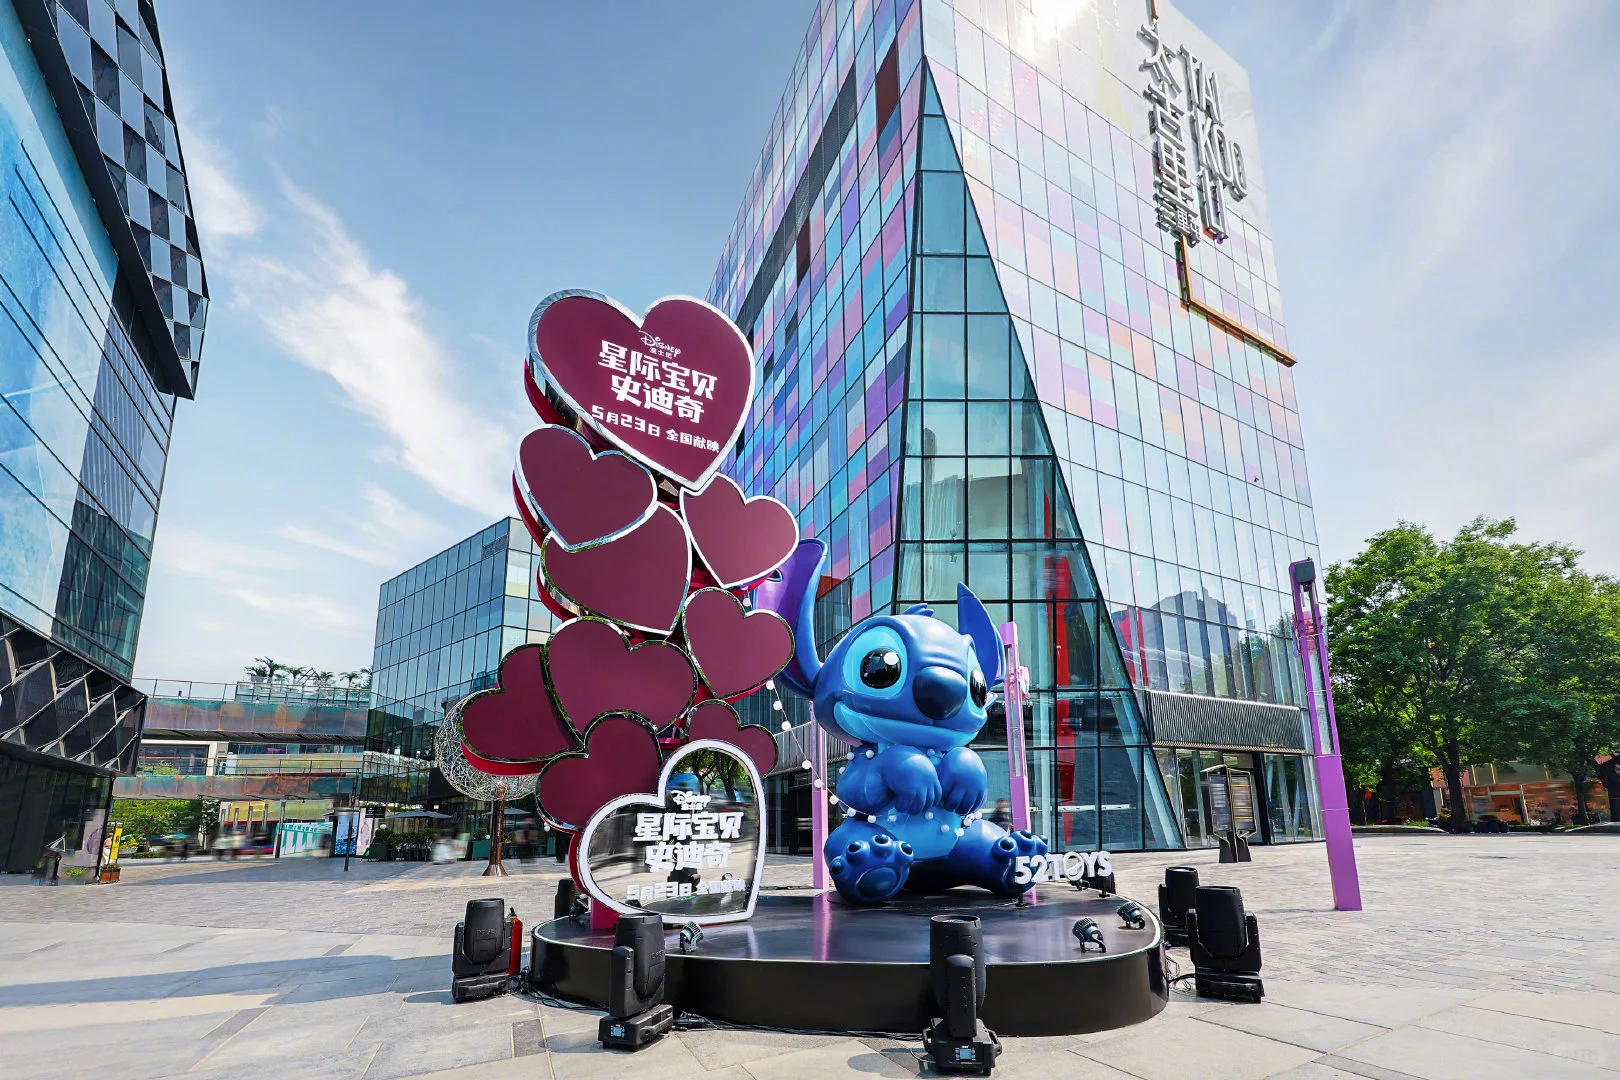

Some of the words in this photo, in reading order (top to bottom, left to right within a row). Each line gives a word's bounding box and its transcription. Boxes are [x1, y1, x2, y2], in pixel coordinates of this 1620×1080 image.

[1179, 43, 1224, 127] TAI
[1136, 18, 1198, 218] 太古里
[1194, 104, 1248, 197] KOO
[1200, 164, 1228, 239] LI
[597, 339, 718, 400] 星际宝贝
[611, 374, 705, 424] 史迪奇
[591, 404, 660, 437] 5月23日
[665, 428, 720, 453] 全国献映
[632, 811, 744, 842] 星际宝贝
[644, 841, 732, 873] 史迪奇
[1014, 850, 1113, 885] 52TOYS
